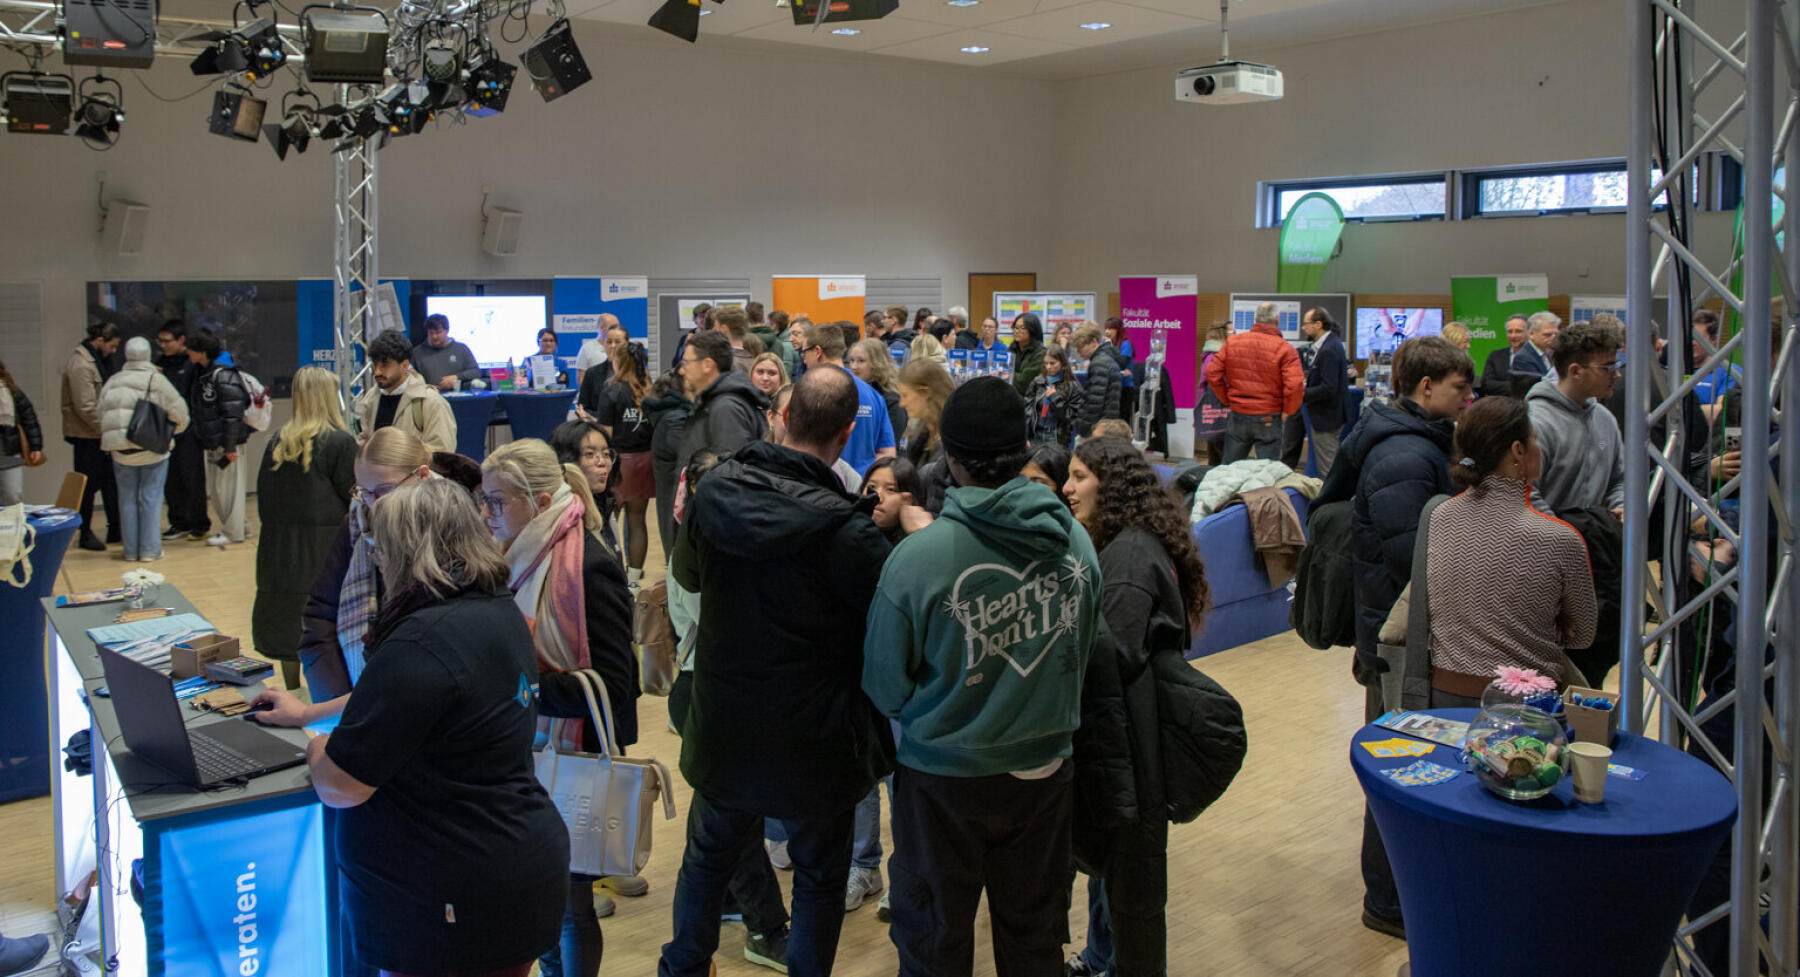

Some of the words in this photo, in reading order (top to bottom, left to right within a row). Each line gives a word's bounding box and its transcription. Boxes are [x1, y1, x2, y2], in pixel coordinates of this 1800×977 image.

[1123, 307, 1150, 317] Fakultät
[1123, 318, 1152, 329] Soziale
[1153, 318, 1182, 329] Arbeit
[1469, 328, 1496, 339] edien
[962, 571, 1060, 632] Hearts
[964, 609, 1037, 670] Don't
[1041, 593, 1083, 635] Lie
[233, 862, 259, 977] eraten.
